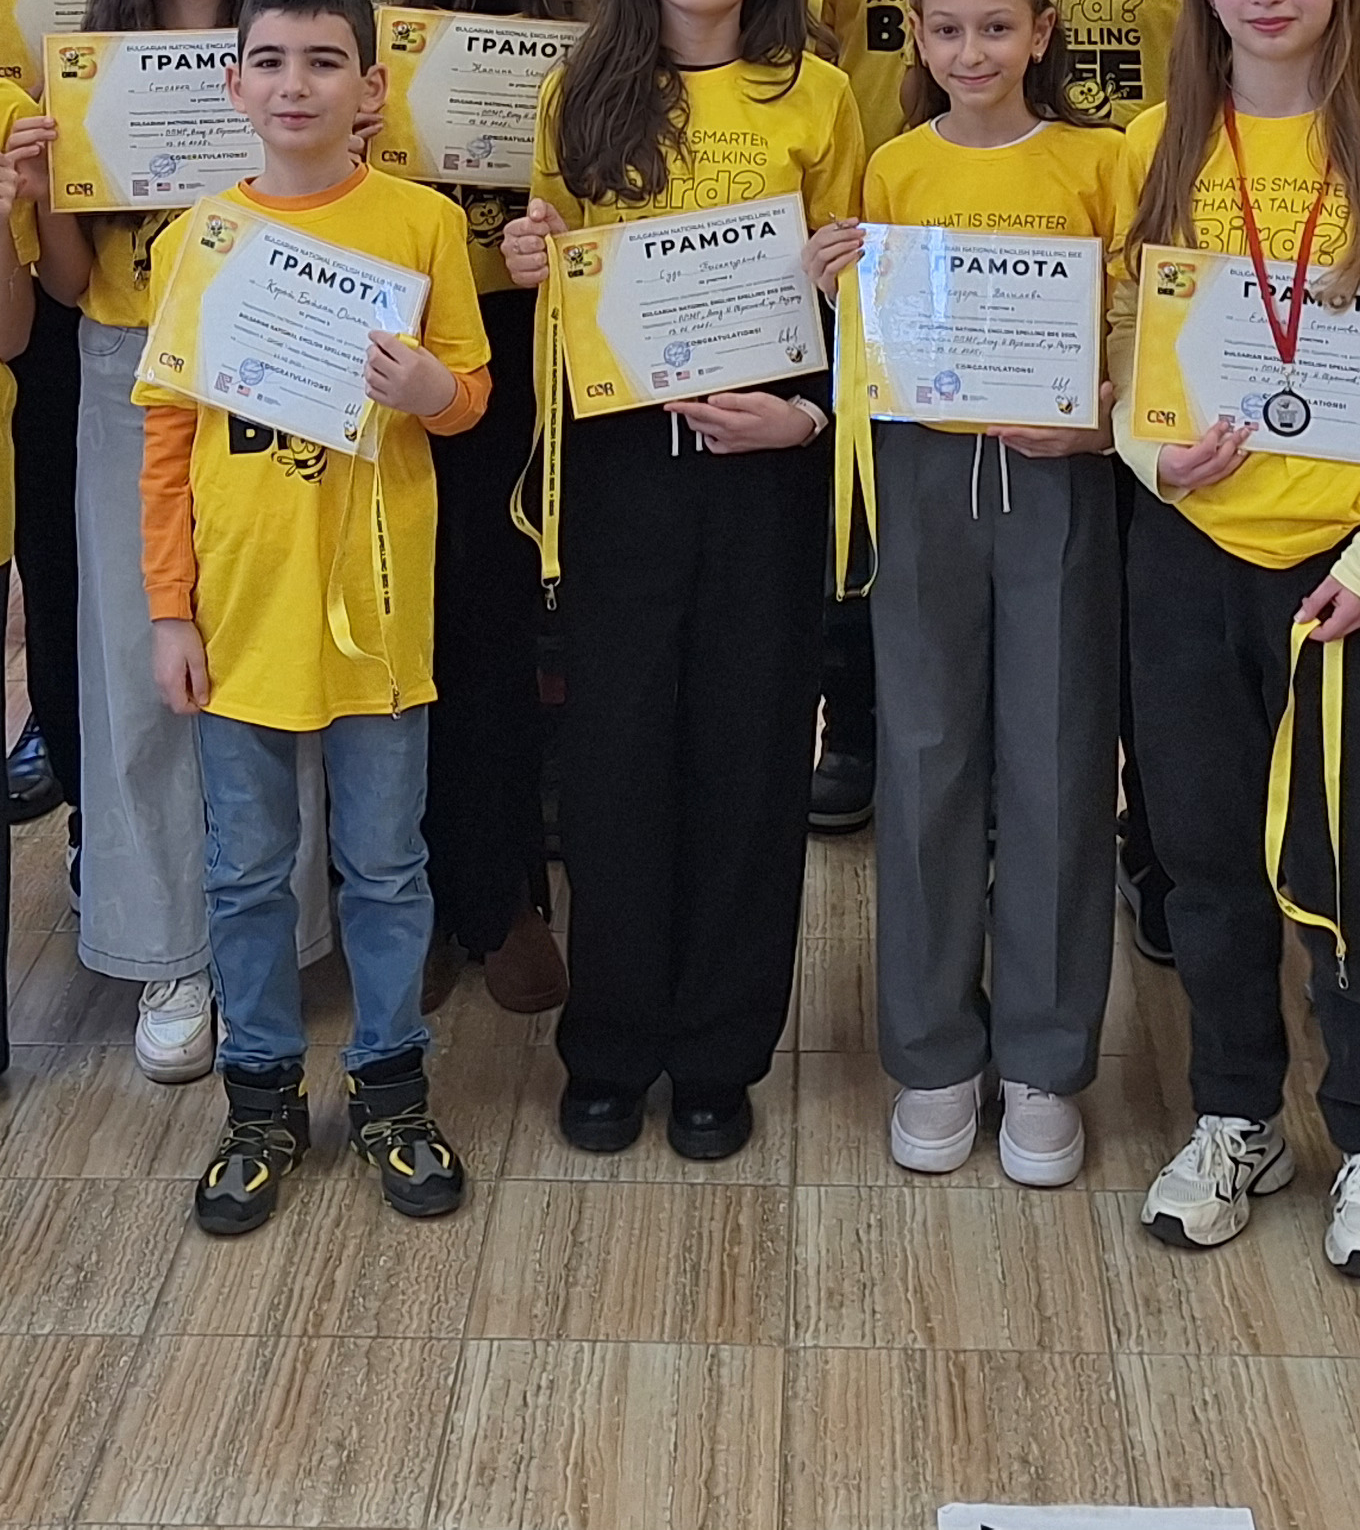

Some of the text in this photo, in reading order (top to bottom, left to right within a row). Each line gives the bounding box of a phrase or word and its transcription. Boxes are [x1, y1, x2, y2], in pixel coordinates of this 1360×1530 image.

[1065, 28, 1141, 45] ELLING
[467, 36, 574, 58] ГРАМОТ
[141, 52, 237, 70] ГРАМО
[691, 131, 768, 148] SMARTER
[692, 150, 767, 166] TALKING
[1194, 178, 1344, 197] WHAT IS SMARTE
[1193, 198, 1349, 219] THAN A TALKNG
[968, 214, 982, 227] IS
[987, 214, 1067, 230] SMARTER
[645, 222, 776, 259] ГРАМОТА
[270, 249, 388, 308] ГРАМОТА
